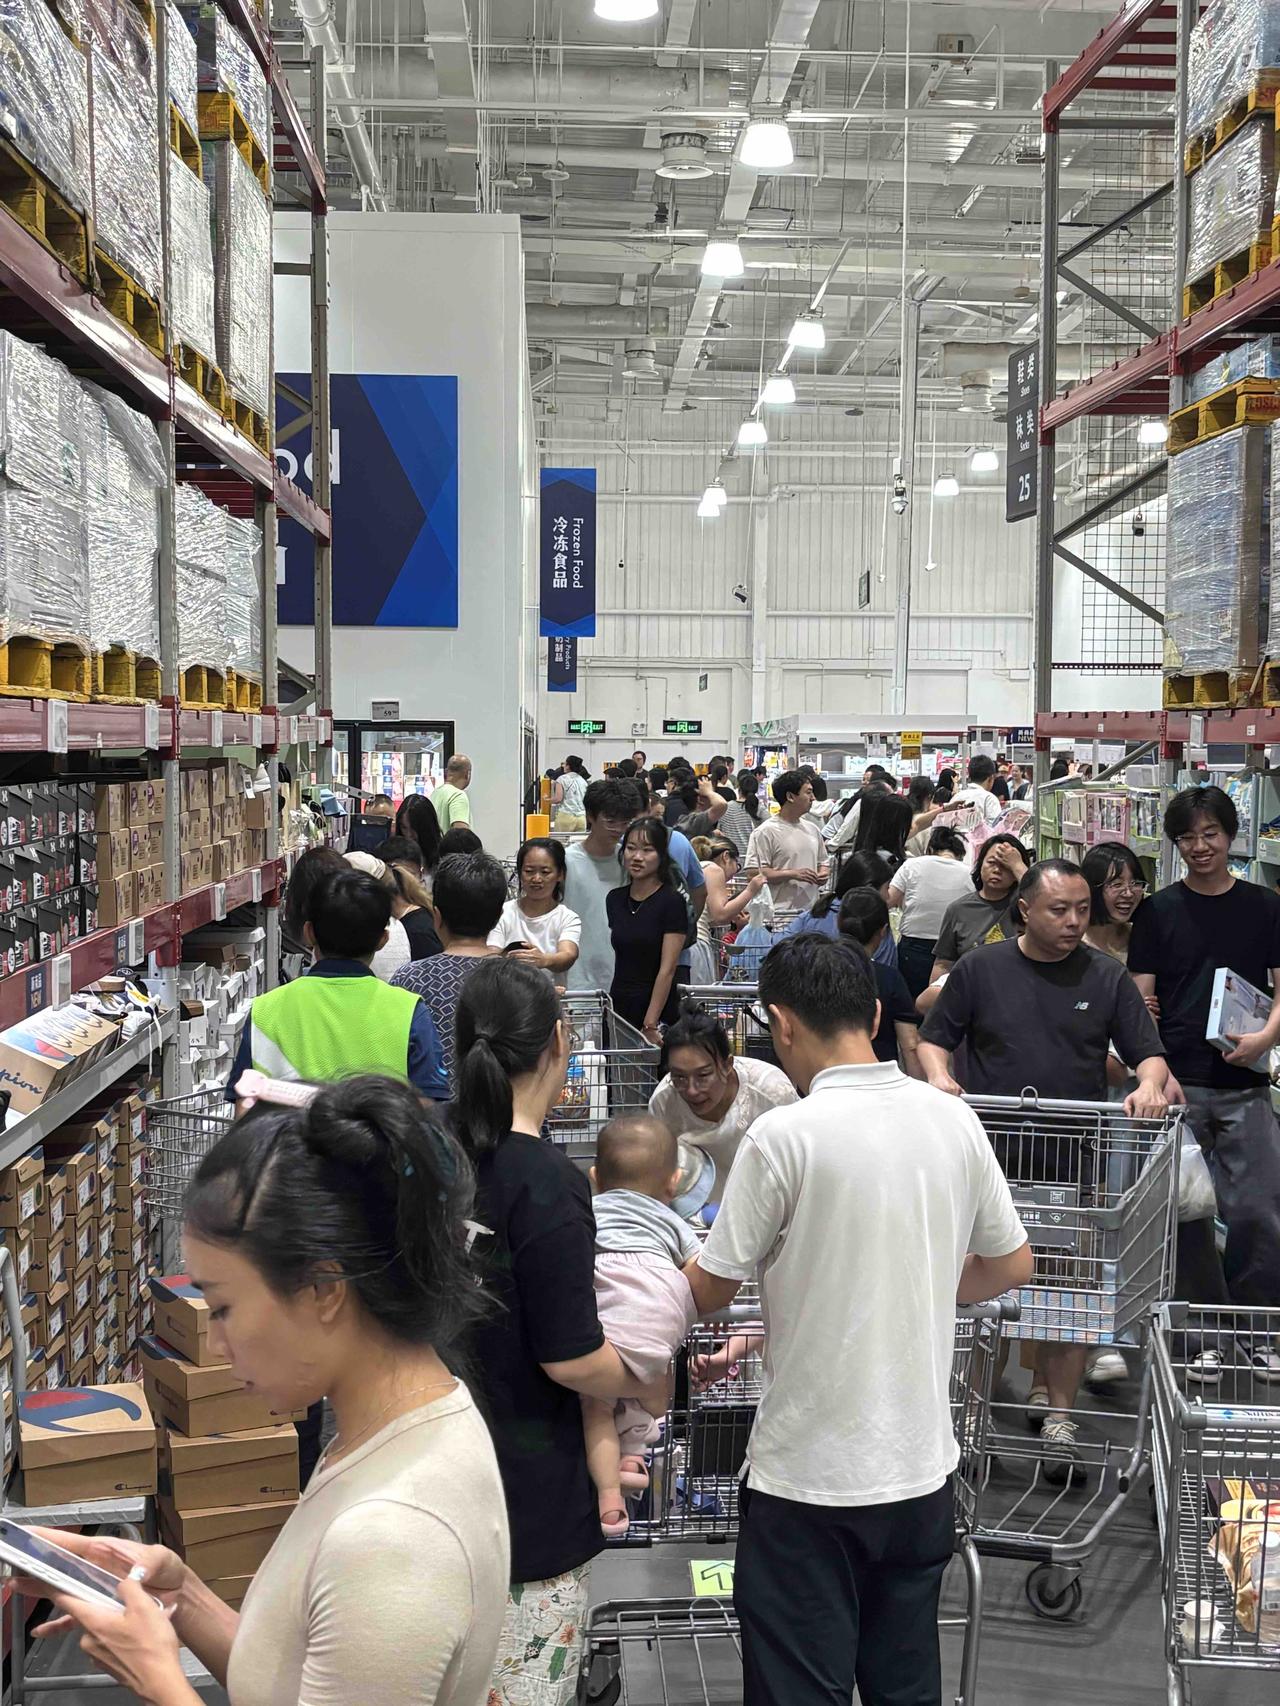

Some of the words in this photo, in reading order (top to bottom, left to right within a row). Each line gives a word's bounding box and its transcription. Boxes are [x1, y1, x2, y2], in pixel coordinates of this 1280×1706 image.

[1018, 473, 1031, 503] 25
[552, 516, 569, 589] 冷冻食品
[572, 517, 584, 556] Frozen
[572, 559, 584, 589] Food
